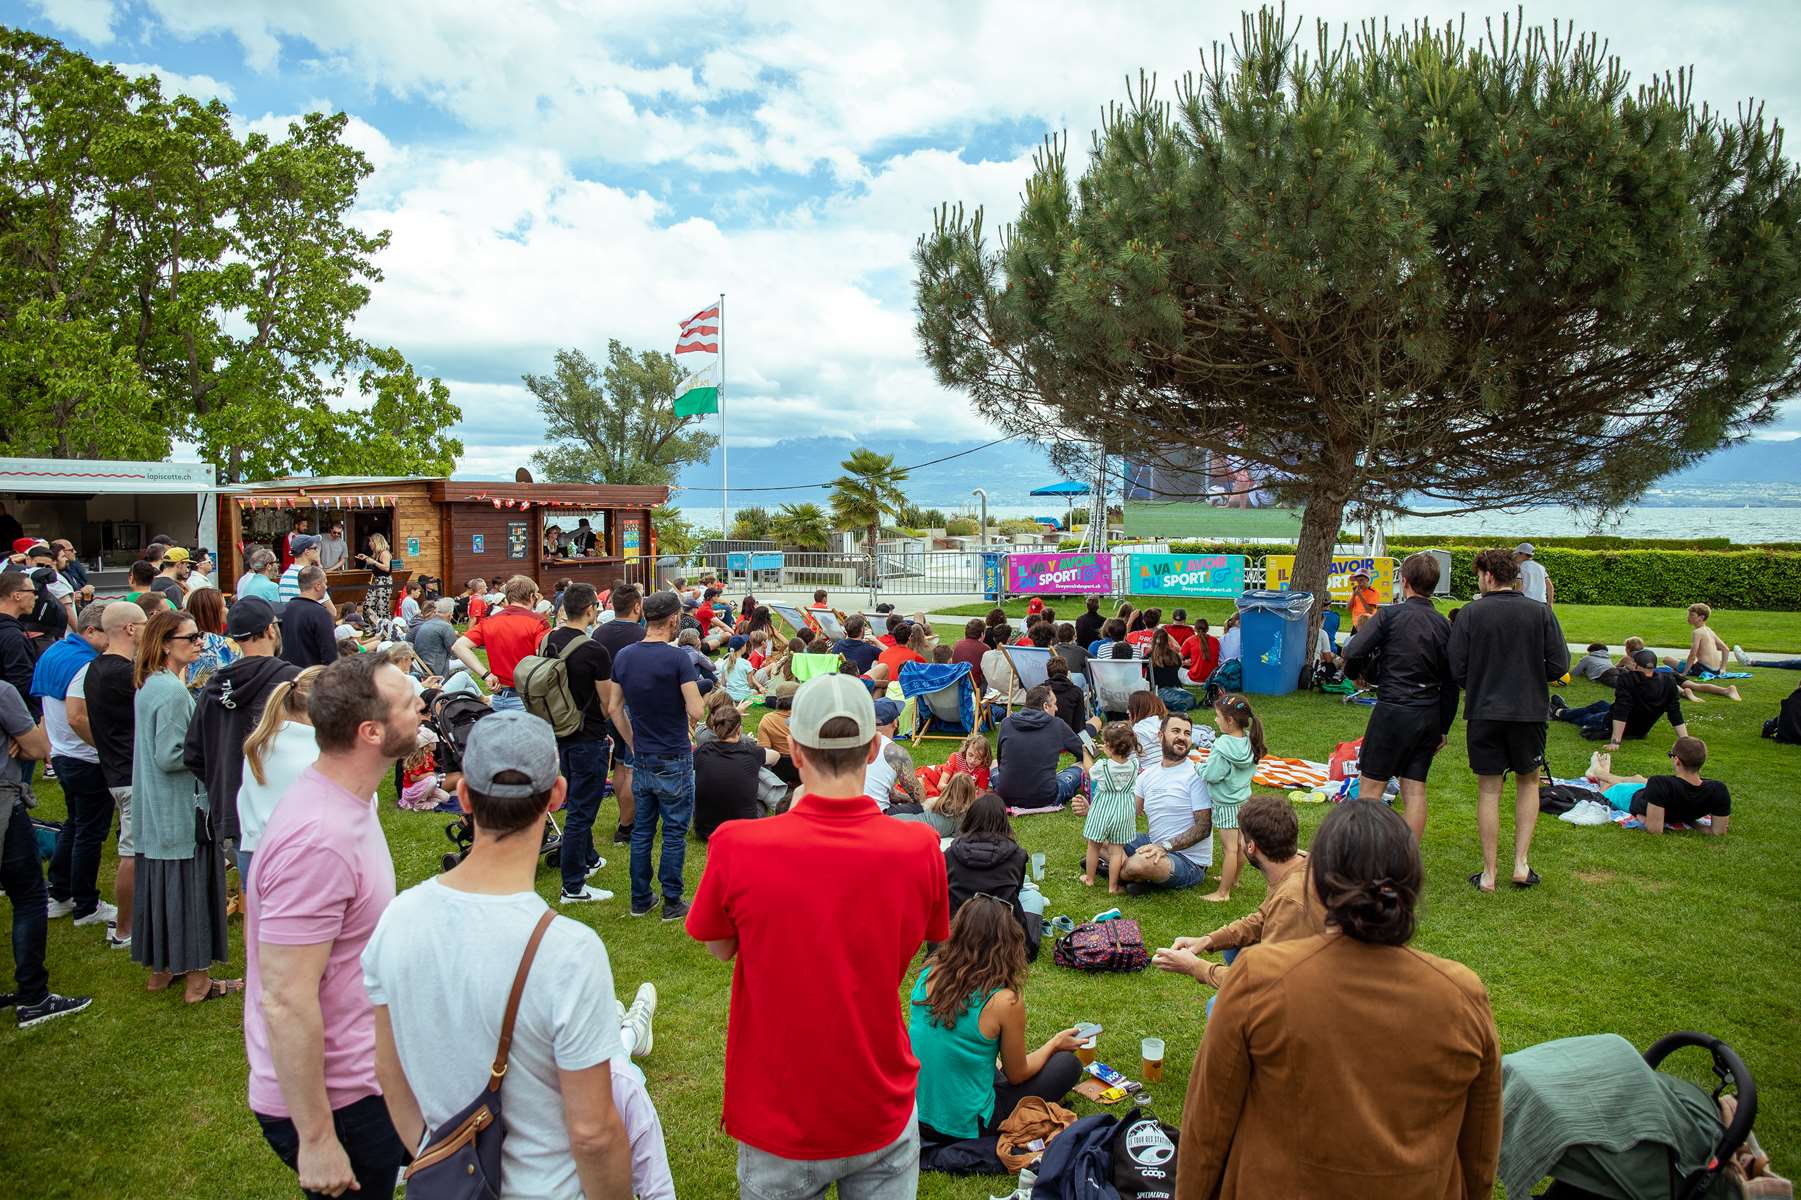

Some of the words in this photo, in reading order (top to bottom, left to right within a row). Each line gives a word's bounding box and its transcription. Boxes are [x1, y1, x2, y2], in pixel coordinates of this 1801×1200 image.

[1030, 562, 1046, 574] VA
[1048, 560, 1056, 573] Y
[1059, 554, 1097, 570] AVOIR
[1140, 566, 1150, 576] IL
[1153, 563, 1171, 575] VA
[1174, 560, 1183, 573] Y
[1186, 556, 1227, 572] AVOIR
[1278, 569, 1289, 580] IL
[1328, 559, 1375, 575] AVOIR
[1020, 576, 1037, 588] DU
[1142, 576, 1160, 589] DU
[1142, 1169, 1166, 1179] coop
[1137, 1191, 1169, 1199] SPECIALIZED
